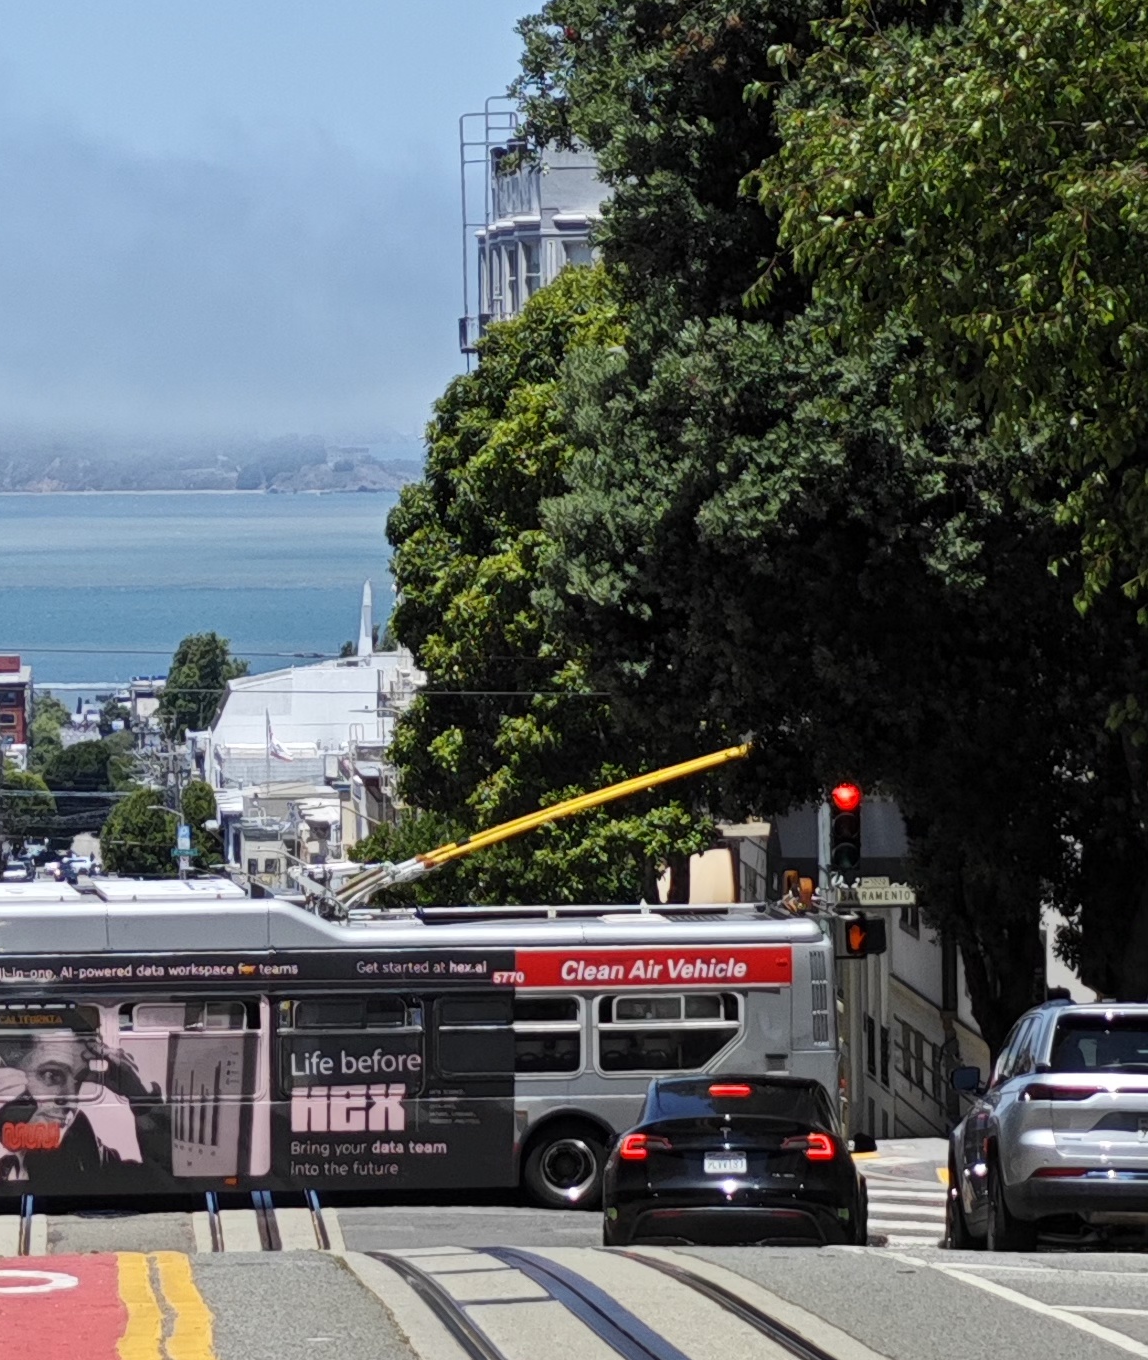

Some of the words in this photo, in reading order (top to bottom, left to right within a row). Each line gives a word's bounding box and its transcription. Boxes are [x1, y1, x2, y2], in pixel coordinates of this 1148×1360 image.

[841, 889, 911, 901] SACRAMENTO
[60, 965, 132, 980] AI-powered
[136, 964, 164, 976] data
[168, 963, 234, 977] workspace
[259, 963, 298, 975] teams
[356, 961, 379, 973] Get
[382, 961, 429, 973] started
[433, 961, 446, 973] at
[449, 961, 487, 973] hex.ai
[561, 960, 624, 981] Clean
[628, 959, 663, 979] Air
[667, 957, 748, 979] Vehicle
[492, 971, 525, 984] 5770
[291, 1051, 334, 1076] Life
[341, 1048, 422, 1074] before
[291, 1140, 330, 1157] Bring
[334, 1142, 367, 1156] your
[371, 1140, 404, 1154] data
[409, 1140, 447, 1154] team
[324, 1160, 349, 1176] the
[353, 1160, 399, 1176] future
